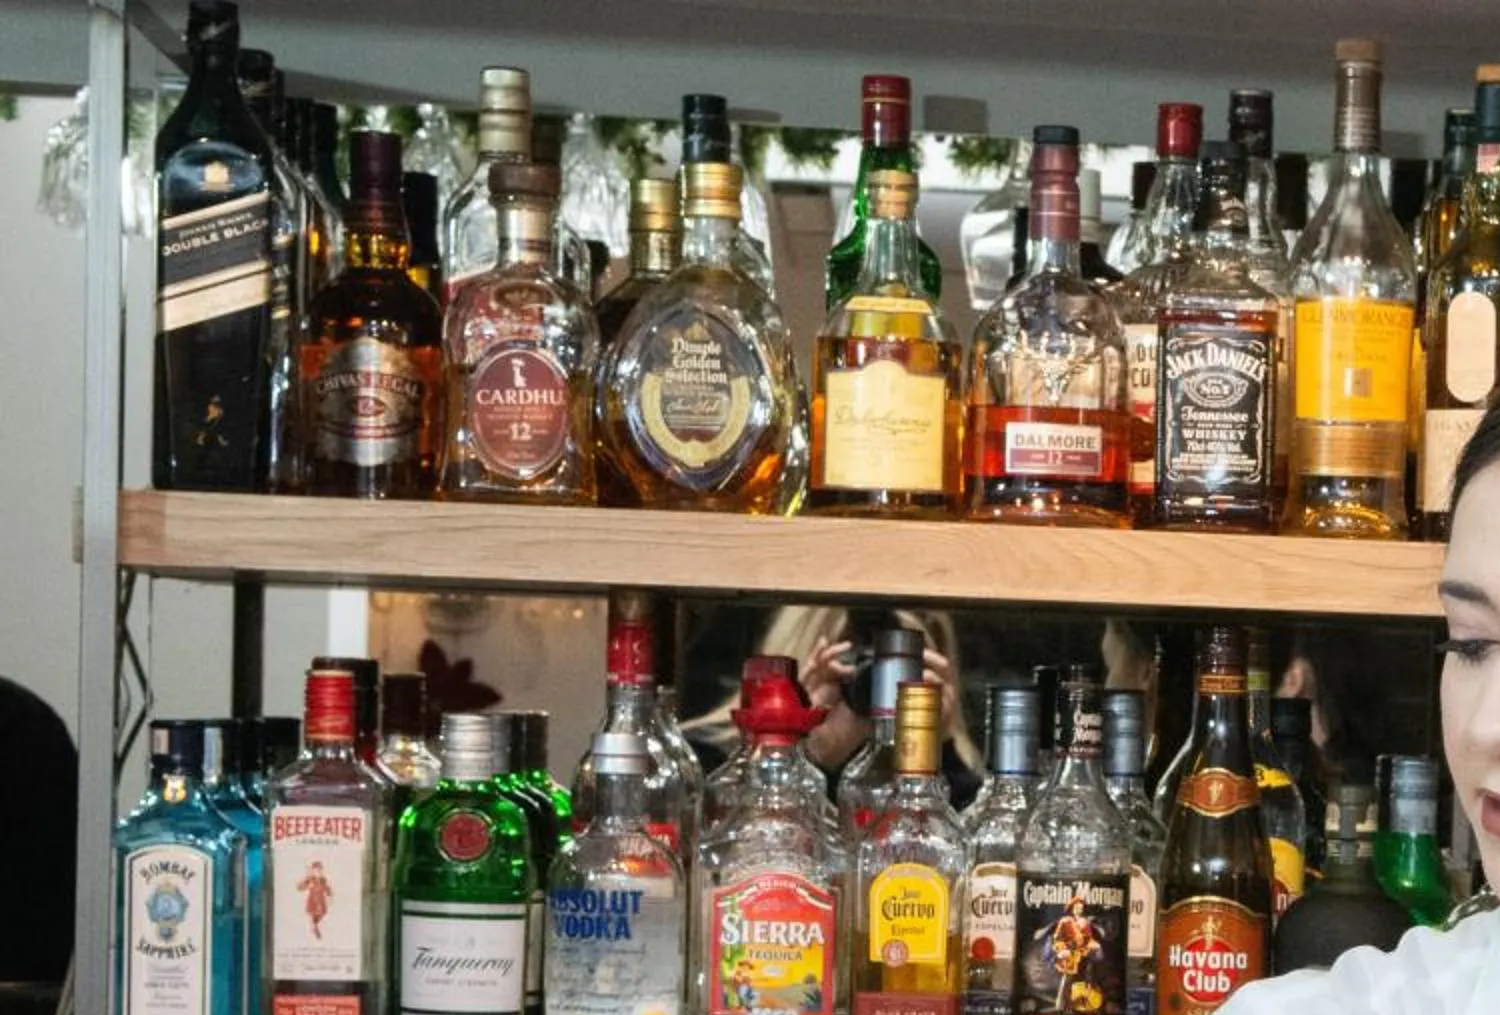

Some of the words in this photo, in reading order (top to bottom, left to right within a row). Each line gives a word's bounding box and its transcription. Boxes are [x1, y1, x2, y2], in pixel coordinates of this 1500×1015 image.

[1165, 349, 1206, 379] JACK
[475, 389, 566, 405] CARDHU
[510, 424, 532, 441] 12
[1014, 432, 1097, 449] DALMORE
[1183, 429, 1246, 440] WHISKEY
[275, 815, 363, 843] BEEFEATER
[139, 861, 197, 885] BOMBAY
[1023, 880, 1073, 909] Captain
[881, 895, 936, 921] Cuervo
[719, 911, 826, 947] SIERRA
[412, 946, 516, 977] Tanqueray
[1169, 944, 1248, 969] Havana
[1183, 969, 1231, 993] Club
